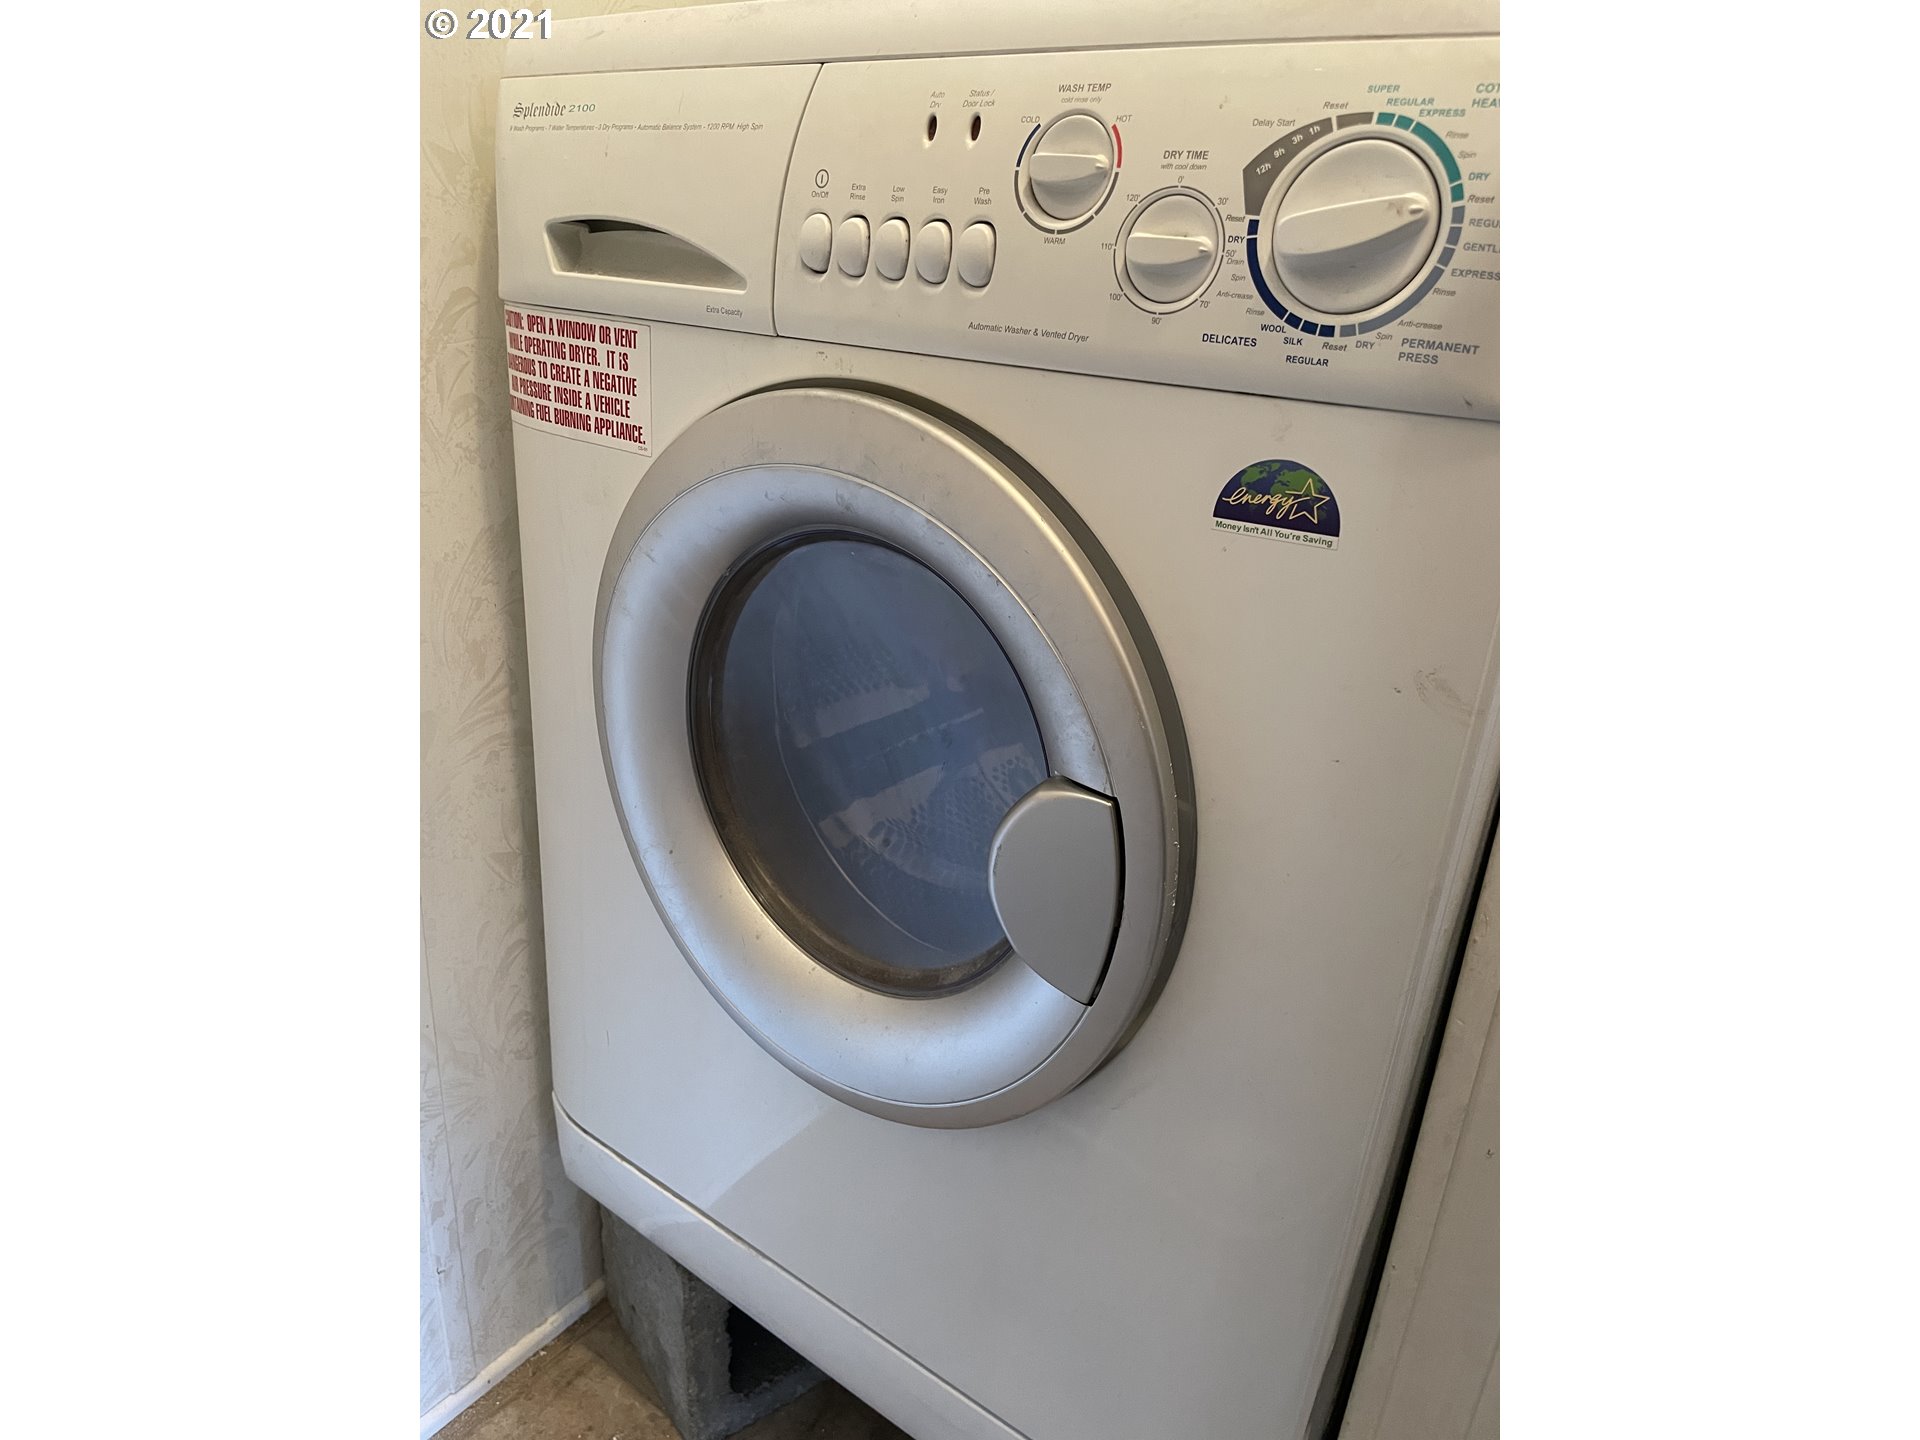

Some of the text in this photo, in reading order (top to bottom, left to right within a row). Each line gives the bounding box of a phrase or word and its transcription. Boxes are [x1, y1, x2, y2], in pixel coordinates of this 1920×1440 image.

[1058, 83, 1112, 93] WASH TEMP
[1367, 84, 1401, 93] SUPER
[930, 90, 945, 99] Auto
[968, 89, 990, 98] Status
[962, 99, 996, 108] Door Lock
[1323, 101, 1349, 110] Reset
[1386, 97, 1435, 107] REGULAR
[513, 101, 596, 120] Splendide 2100
[1418, 108, 1466, 118] EXPRESS
[1020, 115, 1040, 124] COLD
[1115, 114, 1132, 123] HOT
[1252, 118, 1296, 128] Delay Start
[637, 123, 661, 131] Automatic
[683, 123, 702, 132] System
[707, 122, 720, 130] 1200
[720, 122, 735, 130] RPM
[737, 122, 750, 132] High
[750, 122, 764, 131] Spin
[1308, 124, 1321, 135] 1h
[1291, 133, 1304, 145] 3h
[1445, 130, 1470, 139] Rinse
[1163, 150, 1209, 160] DRY TIME
[1273, 146, 1286, 158] 9h
[1457, 150, 1477, 161] Spin
[1160, 162, 1174, 170] with
[1189, 163, 1207, 171] down
[1255, 162, 1272, 175] 12h
[1468, 172, 1490, 181] DRY
[851, 183, 866, 191] Extra
[892, 185, 905, 193] Low
[932, 186, 948, 196] Easy
[978, 187, 990, 195] Pre
[811, 190, 830, 199] On/Off
[849, 193, 866, 201] Rinse
[890, 194, 905, 203] Spin
[1467, 194, 1495, 204] Reset
[932, 196, 945, 204] Iron
[973, 197, 992, 206] Wash
[1225, 214, 1246, 223] Reset
[1043, 236, 1066, 245] WARM
[1227, 235, 1245, 244] DRY
[1226, 258, 1245, 266] Drain
[1230, 273, 1246, 282] Spin
[1450, 268, 1500, 281] EXPRESS
[1216, 290, 1254, 300] Anti-crease
[1432, 287, 1456, 297] Rinse
[706, 304, 719, 314] Extra
[1245, 307, 1265, 316] Rinse
[1260, 323, 1287, 334] WOOL
[1397, 319, 1443, 331] Anti-crease
[527, 314, 546, 334] OPEN
[549, 317, 554, 336] A
[556, 318, 596, 342] WINDOW
[599, 325, 611, 345] OR
[613, 327, 638, 349] VENT
[968, 321, 1090, 343] Automatic Washer & Vented Dryer
[1375, 331, 1393, 342] Spin
[1202, 333, 1257, 347] DELICATES
[1283, 337, 1303, 346] SILK
[1355, 340, 1375, 350] DRY
[1321, 342, 1347, 352] Reset
[1401, 337, 1480, 355] PERMANENT
[524, 335, 566, 361] OPERATING
[569, 344, 601, 367] DRYER.
[607, 350, 616, 369] IT
[1286, 355, 1329, 367] REGULAR
[1398, 351, 1439, 365] PRESS
[538, 360, 548, 379] TO
[550, 363, 581, 386] CREATE
[584, 369, 590, 388] A
[592, 371, 637, 397] NEGATIVE
[519, 377, 552, 402] PRESSURE
[554, 386, 583, 409] INSIDE
[585, 392, 591, 410] A
[594, 394, 631, 419] VEHICLE
[536, 403, 552, 423] FUEL
[554, 407, 591, 432] BURNING
[594, 416, 646, 445] APPLIANCE.
[1222, 486, 1304, 520] energy
[1215, 520, 1333, 548] Money Isn't All You're Saving
